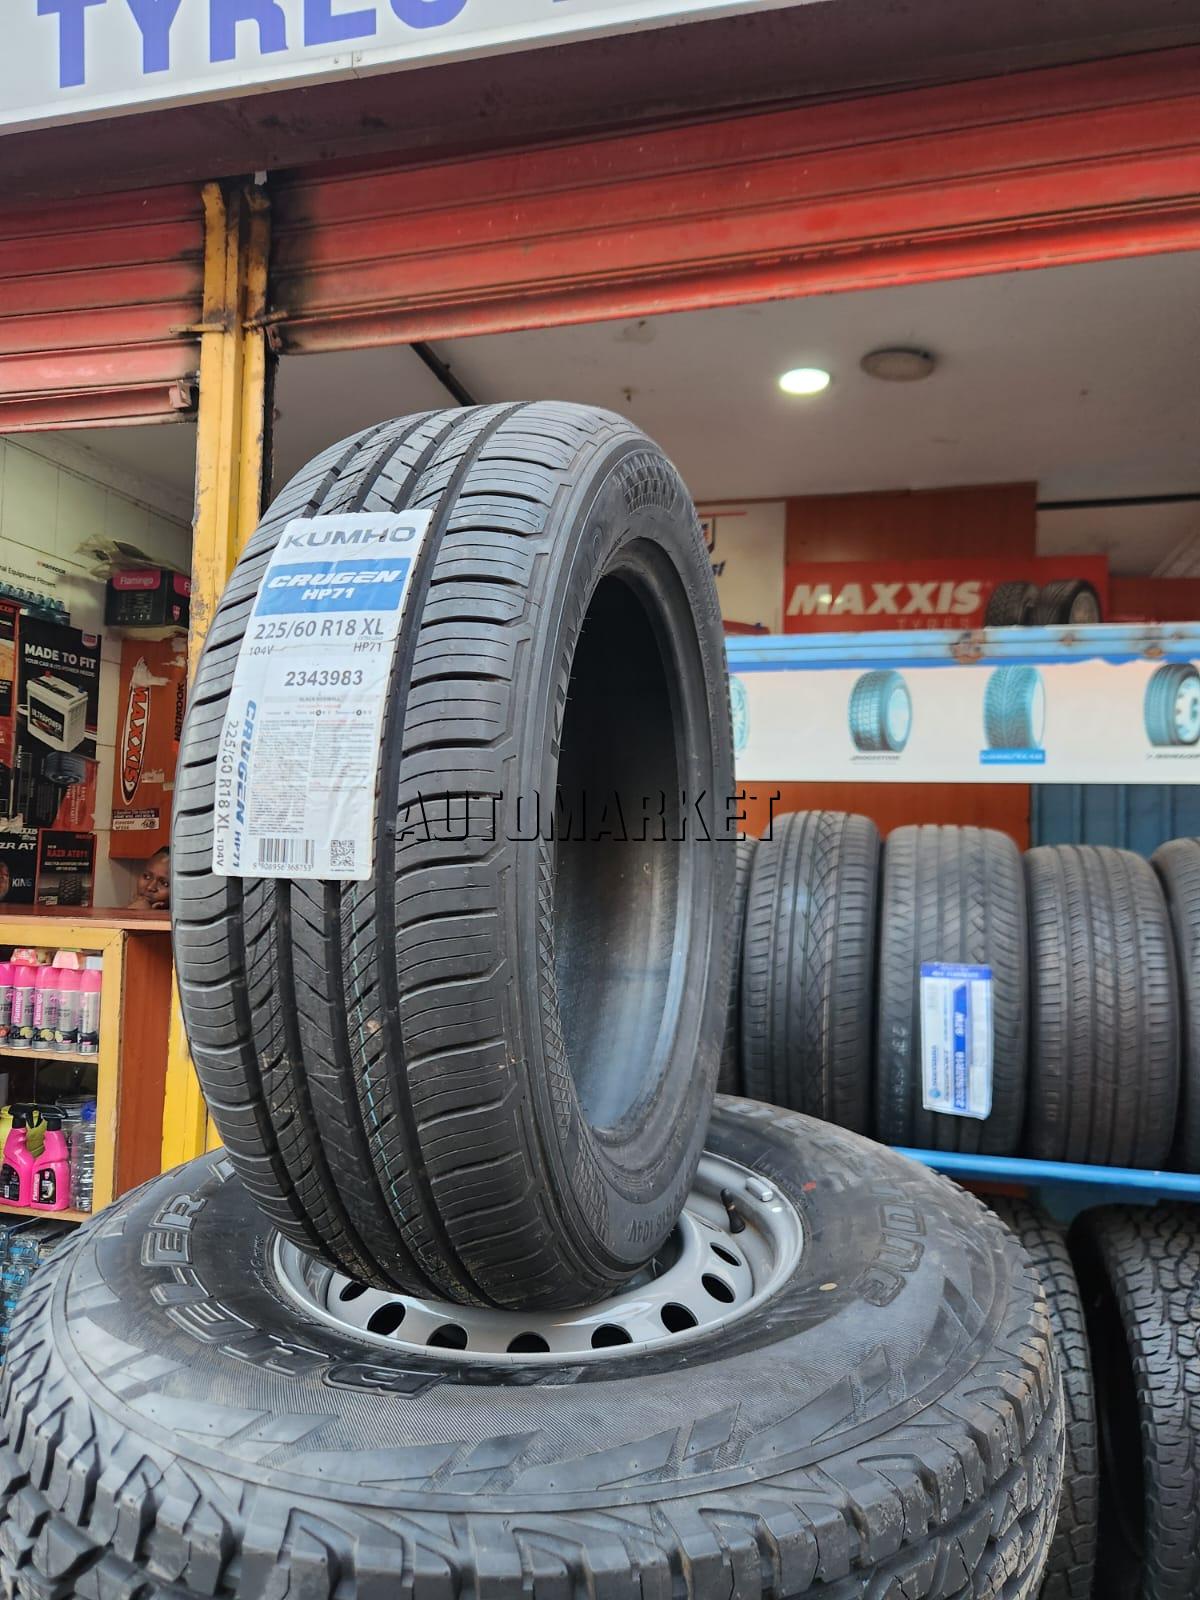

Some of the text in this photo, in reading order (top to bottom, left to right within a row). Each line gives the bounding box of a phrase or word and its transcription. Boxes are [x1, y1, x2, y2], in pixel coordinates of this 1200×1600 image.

[37, 0, 467, 88] TYR
[283, 526, 416, 550] KUMHO
[120, 576, 154, 586] Flamingo
[267, 569, 401, 589] CRUGEN
[301, 588, 355, 601] HP71
[786, 581, 983, 616] MAXXIS
[254, 618, 384, 640] 225/60 R18 XL
[24, 643, 97, 669] MADE TO FIT
[250, 645, 274, 657] 104V
[353, 641, 382, 653] HP71
[284, 670, 363, 687] 2343983
[235, 700, 257, 825] CRUGEN
[216, 720, 239, 867] 225/60 R18 XL 104V
[18, 842, 37, 850] AT
[233, 831, 241, 867] HP71
